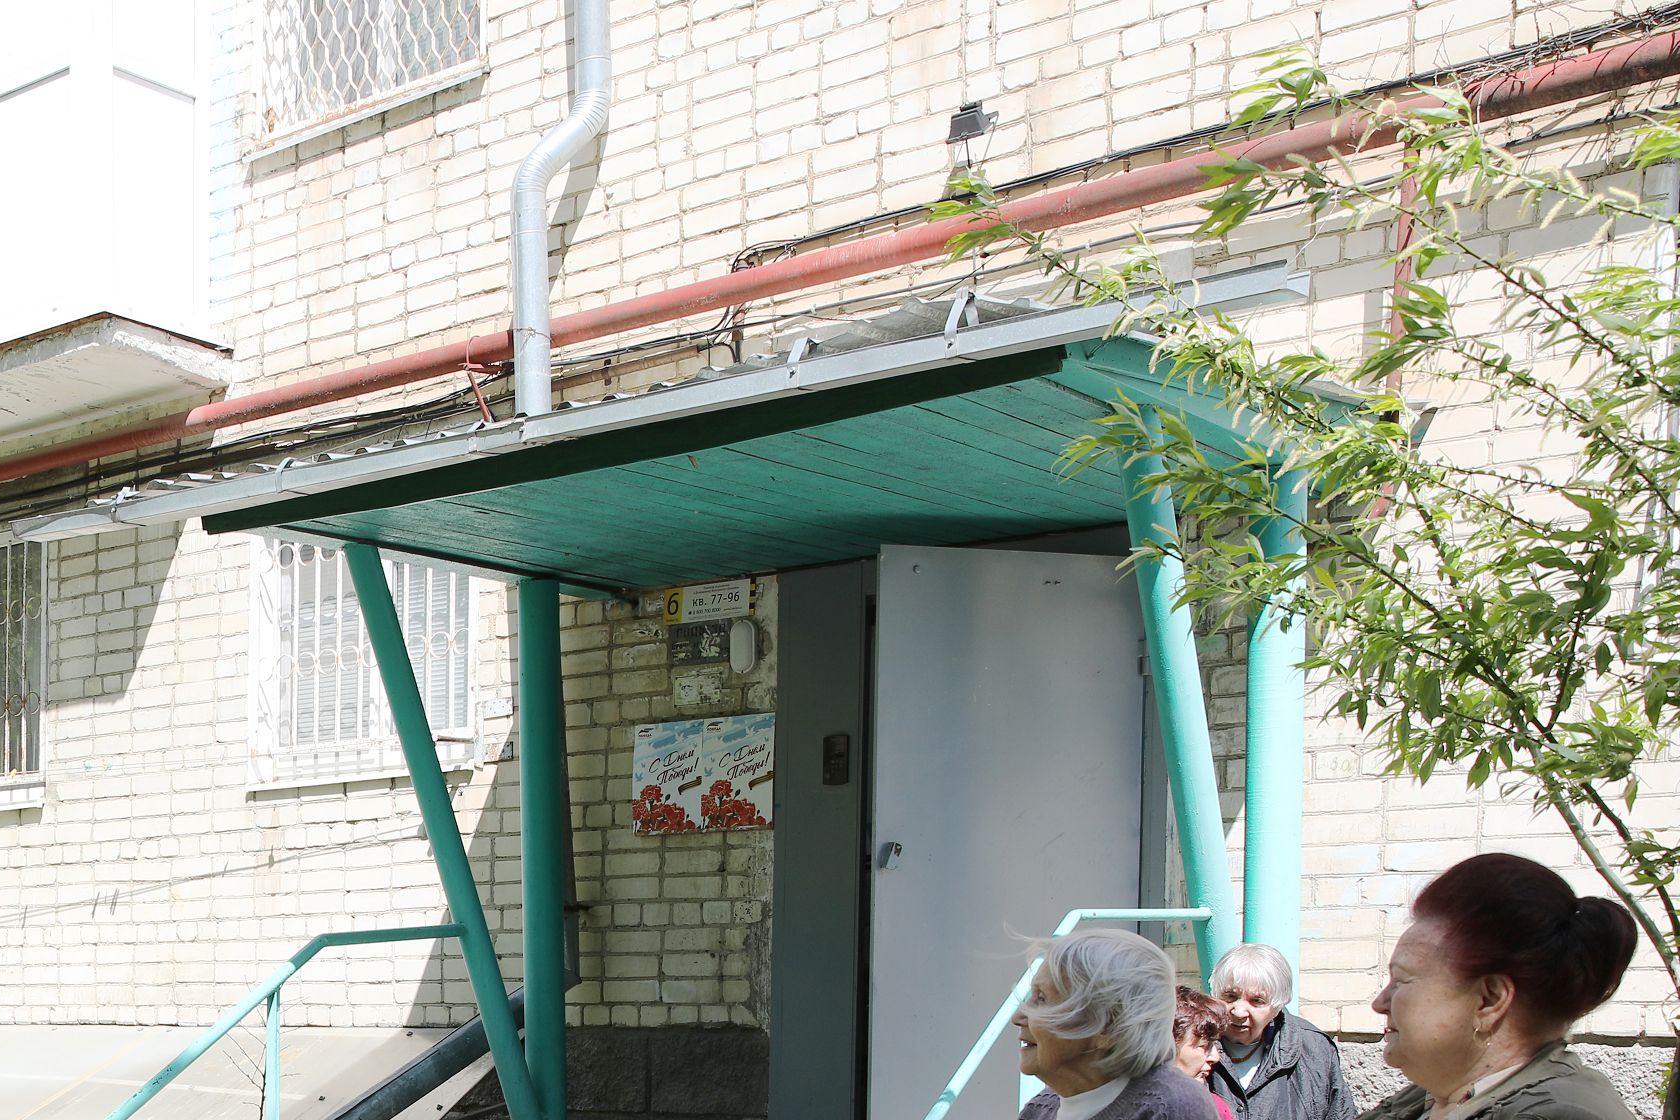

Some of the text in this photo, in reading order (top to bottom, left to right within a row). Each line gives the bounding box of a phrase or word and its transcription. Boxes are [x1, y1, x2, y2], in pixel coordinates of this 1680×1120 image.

[667, 592, 679, 615] 6
[692, 598, 707, 607] кв.
[711, 591, 740, 605] 77-96
[649, 758, 660, 773] С
[719, 752, 731, 768] С
[727, 751, 770, 780] Победы!
[657, 757, 699, 785] Победы!
